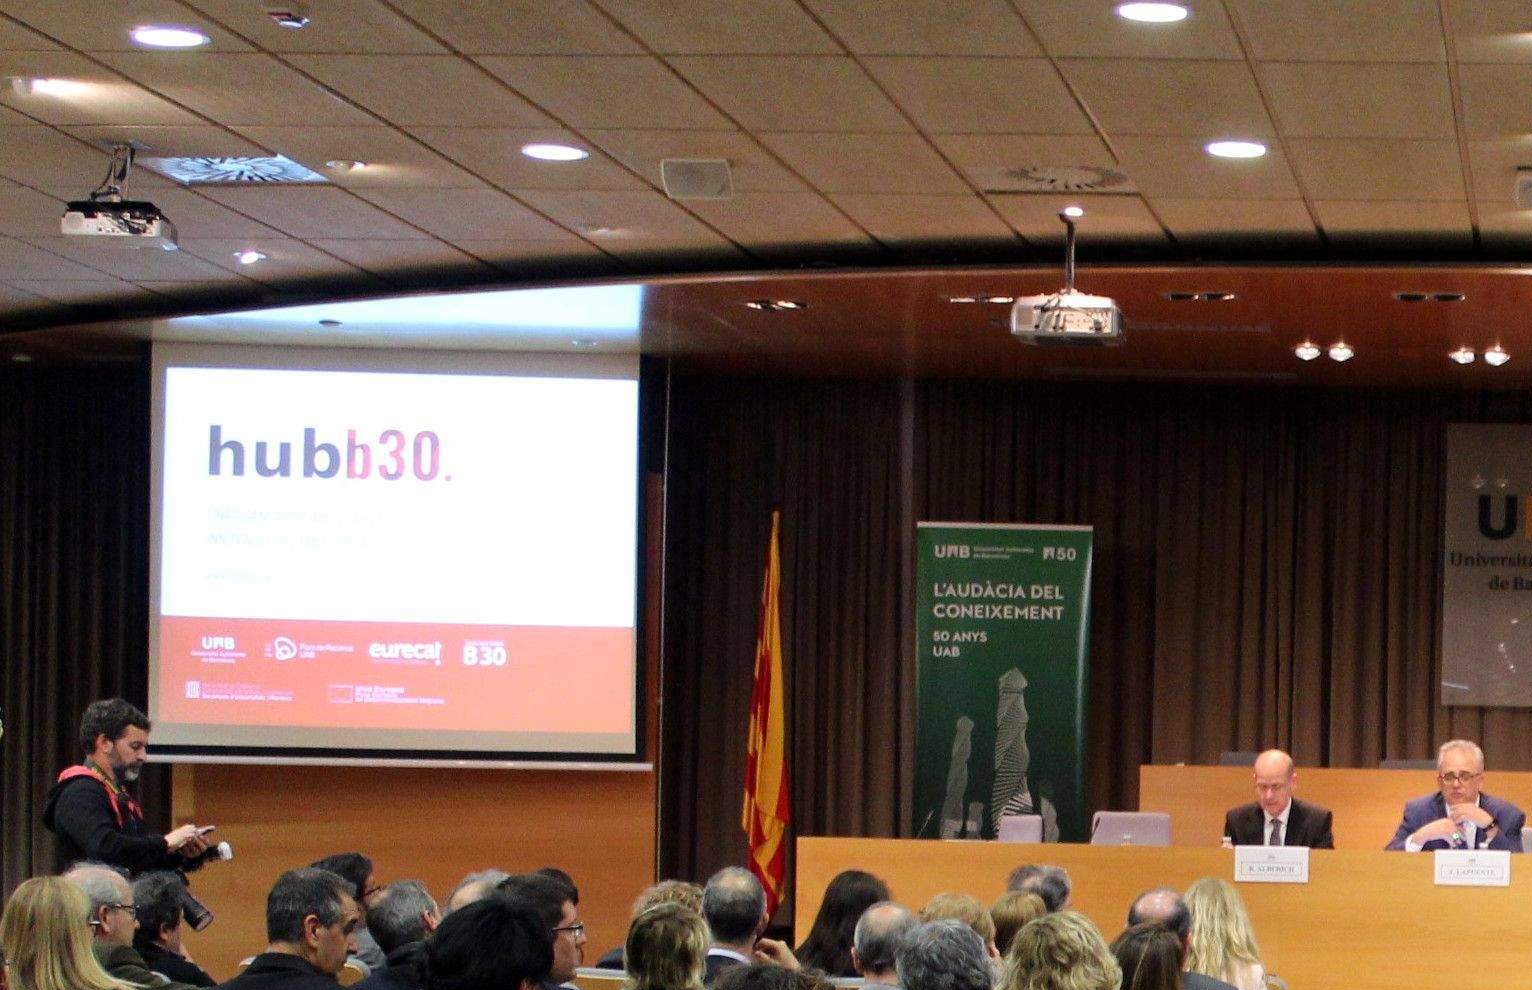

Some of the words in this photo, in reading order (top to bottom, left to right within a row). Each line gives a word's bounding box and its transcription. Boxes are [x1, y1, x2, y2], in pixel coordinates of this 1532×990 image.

[933, 580, 1026, 599] L'AUDÀCIA
[1030, 585, 1064, 600] DEL
[1488, 575, 1509, 591] de
[933, 604, 1064, 620] CONEIXEMENT
[933, 630, 950, 642] 50
[952, 630, 988, 643] ANYS
[932, 646, 960, 658] UAB
